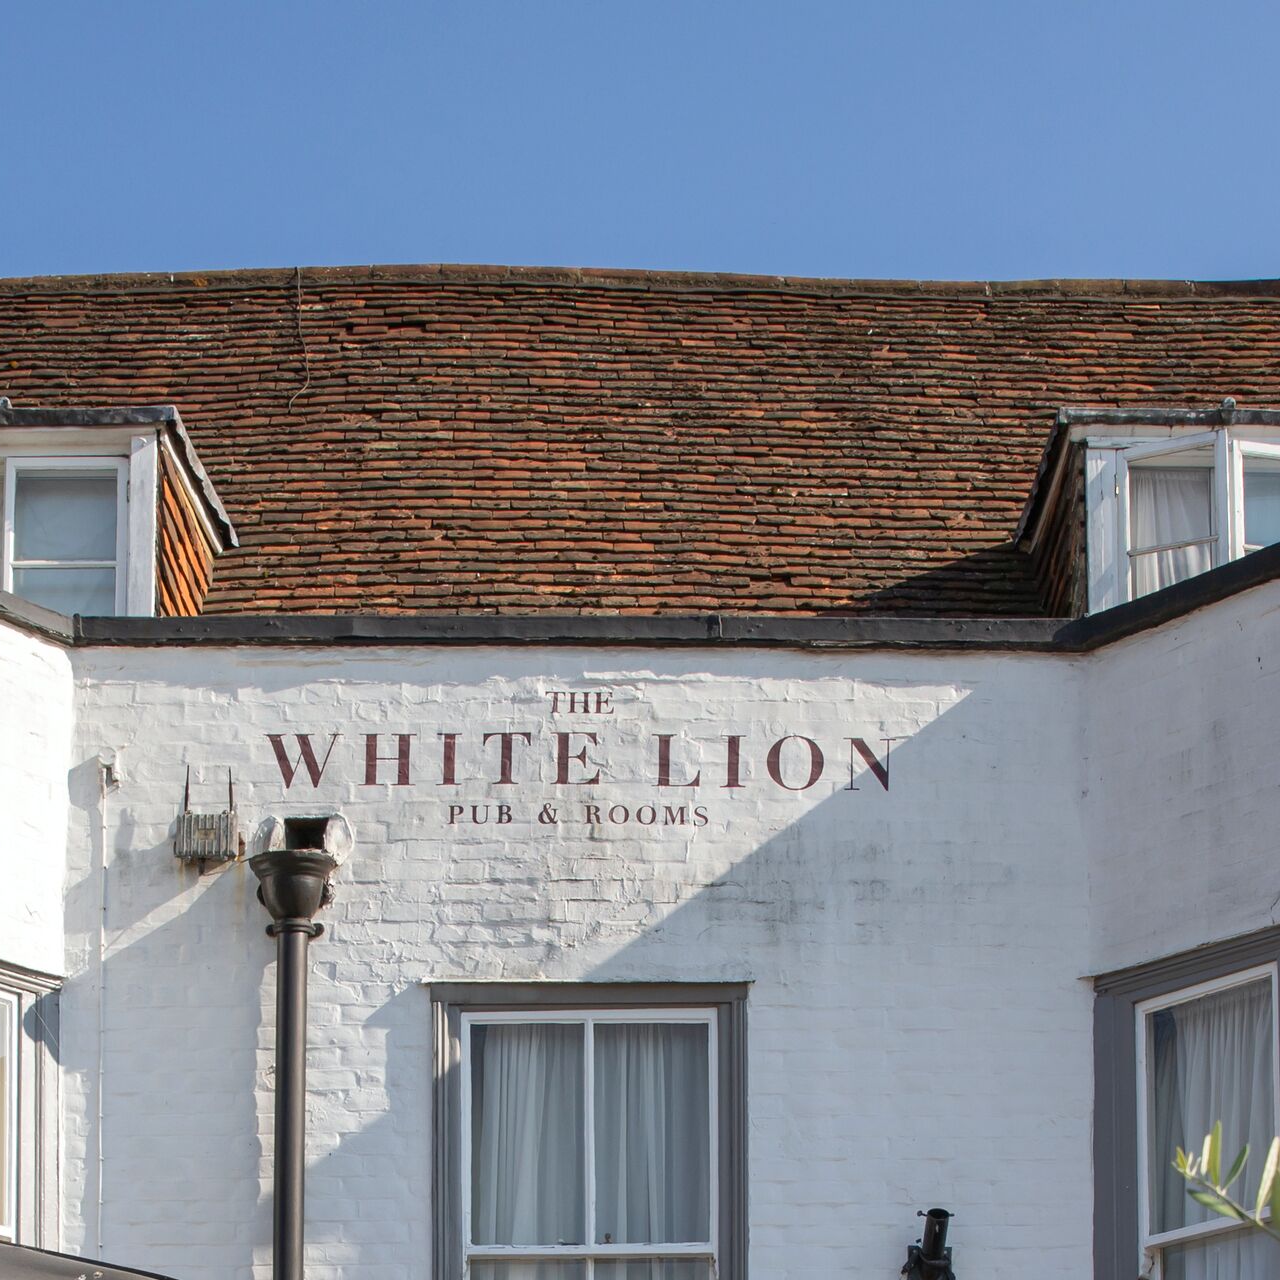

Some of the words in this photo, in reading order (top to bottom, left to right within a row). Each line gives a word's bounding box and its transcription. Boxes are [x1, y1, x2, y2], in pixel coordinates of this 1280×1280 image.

[545, 691, 614, 714] THE
[265, 732, 600, 789] WHITE
[652, 733, 896, 791] LION
[448, 803, 513, 825] PUB
[537, 802, 561, 825] &
[585, 804, 709, 827] ROOMS
